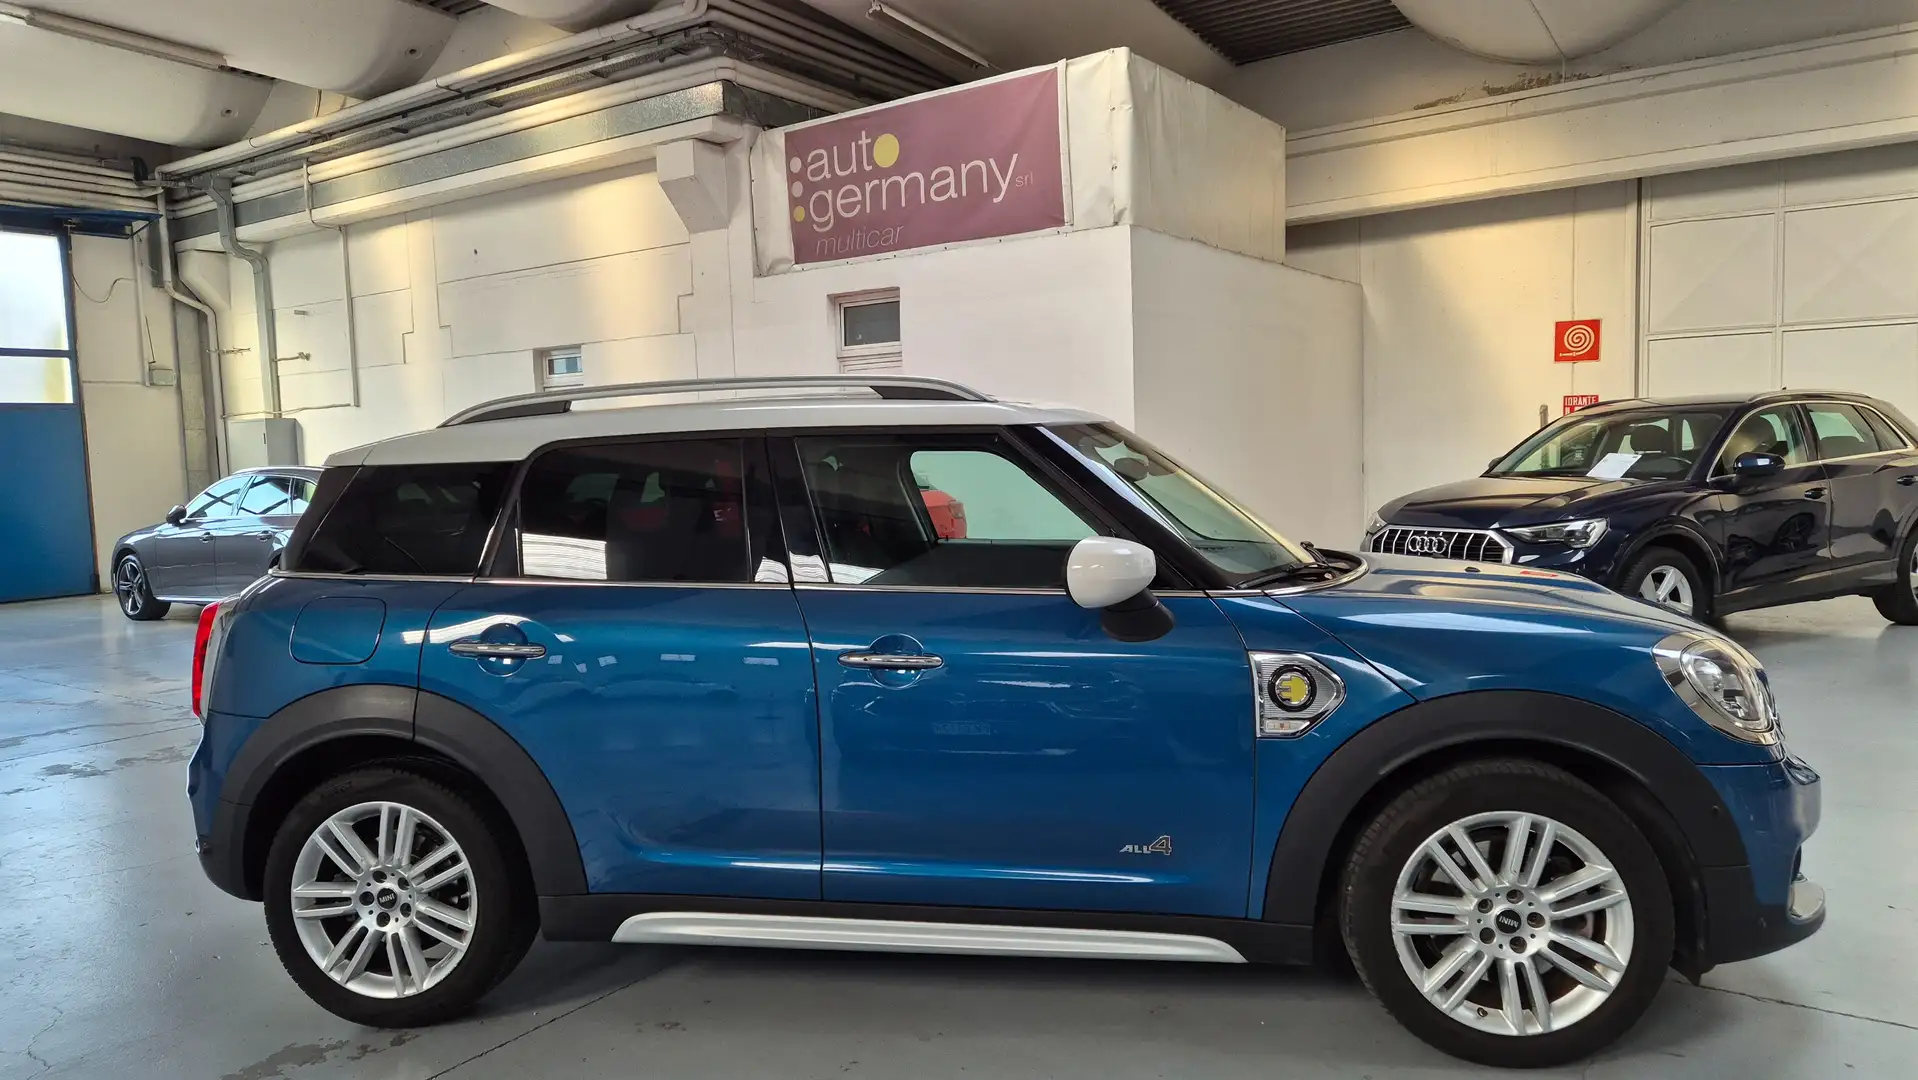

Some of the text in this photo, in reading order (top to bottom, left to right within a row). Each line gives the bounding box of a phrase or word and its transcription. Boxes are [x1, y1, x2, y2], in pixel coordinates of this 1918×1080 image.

[809, 153, 1034, 233] germany srl
[815, 224, 904, 256] multicar
[378, 893, 395, 903] MINI
[1498, 915, 1520, 928] MINI
